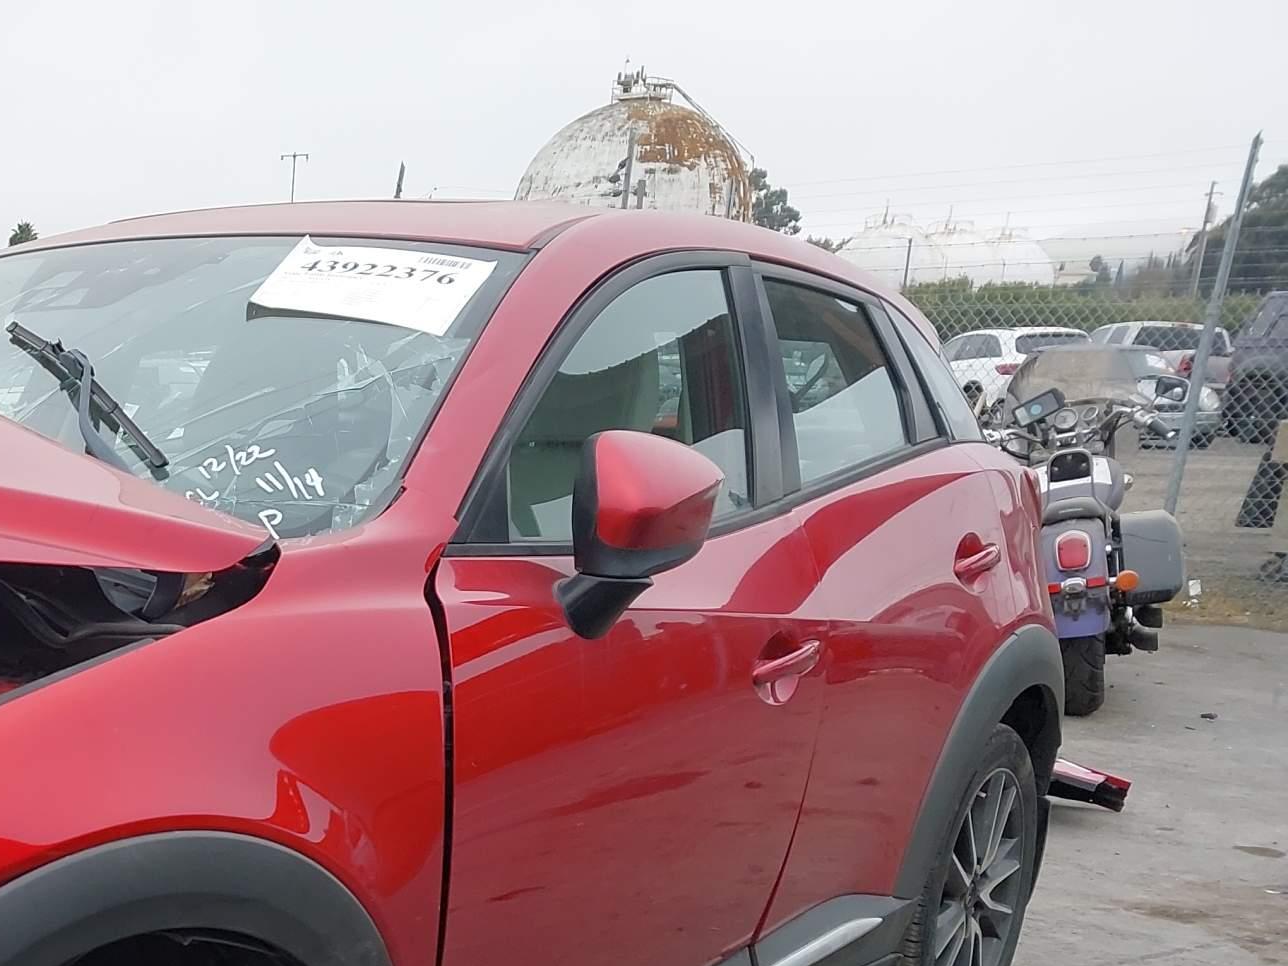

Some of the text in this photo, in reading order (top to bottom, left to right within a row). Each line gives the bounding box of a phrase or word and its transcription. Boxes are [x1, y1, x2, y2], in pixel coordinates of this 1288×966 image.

[300, 259, 459, 286] 43922376
[198, 444, 276, 479] 12/22
[255, 461, 325, 500] 11/14
[258, 509, 283, 540] P
